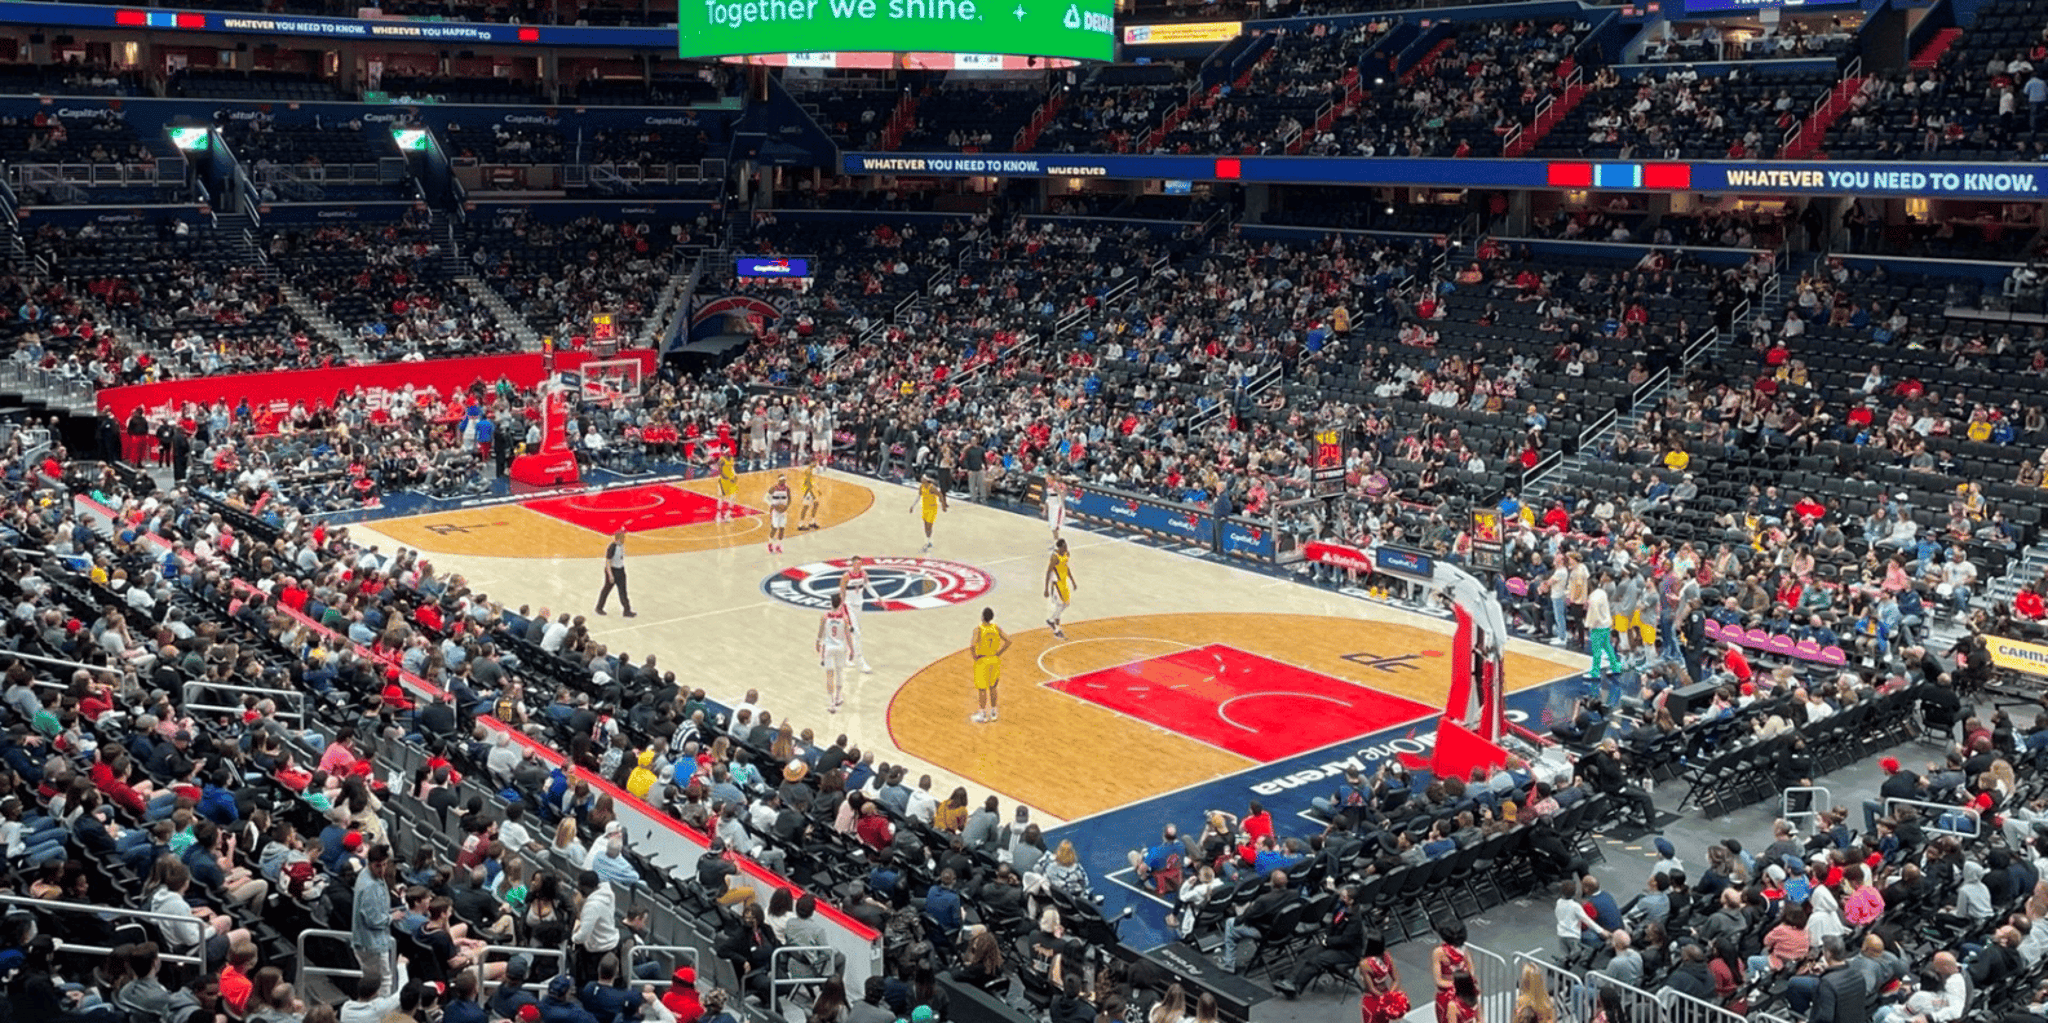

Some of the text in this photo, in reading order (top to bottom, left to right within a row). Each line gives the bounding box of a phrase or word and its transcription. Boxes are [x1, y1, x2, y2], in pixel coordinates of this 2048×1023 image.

[705, 0, 983, 29] Together we shine.
[224, 19, 491, 40] WHATEVER YOU NEED TO KNOW. WHEREVER YOU HAPPEN TO
[863, 158, 926, 170] WHATEVER
[927, 159, 953, 171] YOU
[954, 160, 985, 171] NEED
[986, 160, 1002, 171] TO
[1003, 160, 1039, 172] KNOW.
[1727, 170, 2038, 191] WHATEVER YOU NEED TO KNOW.
